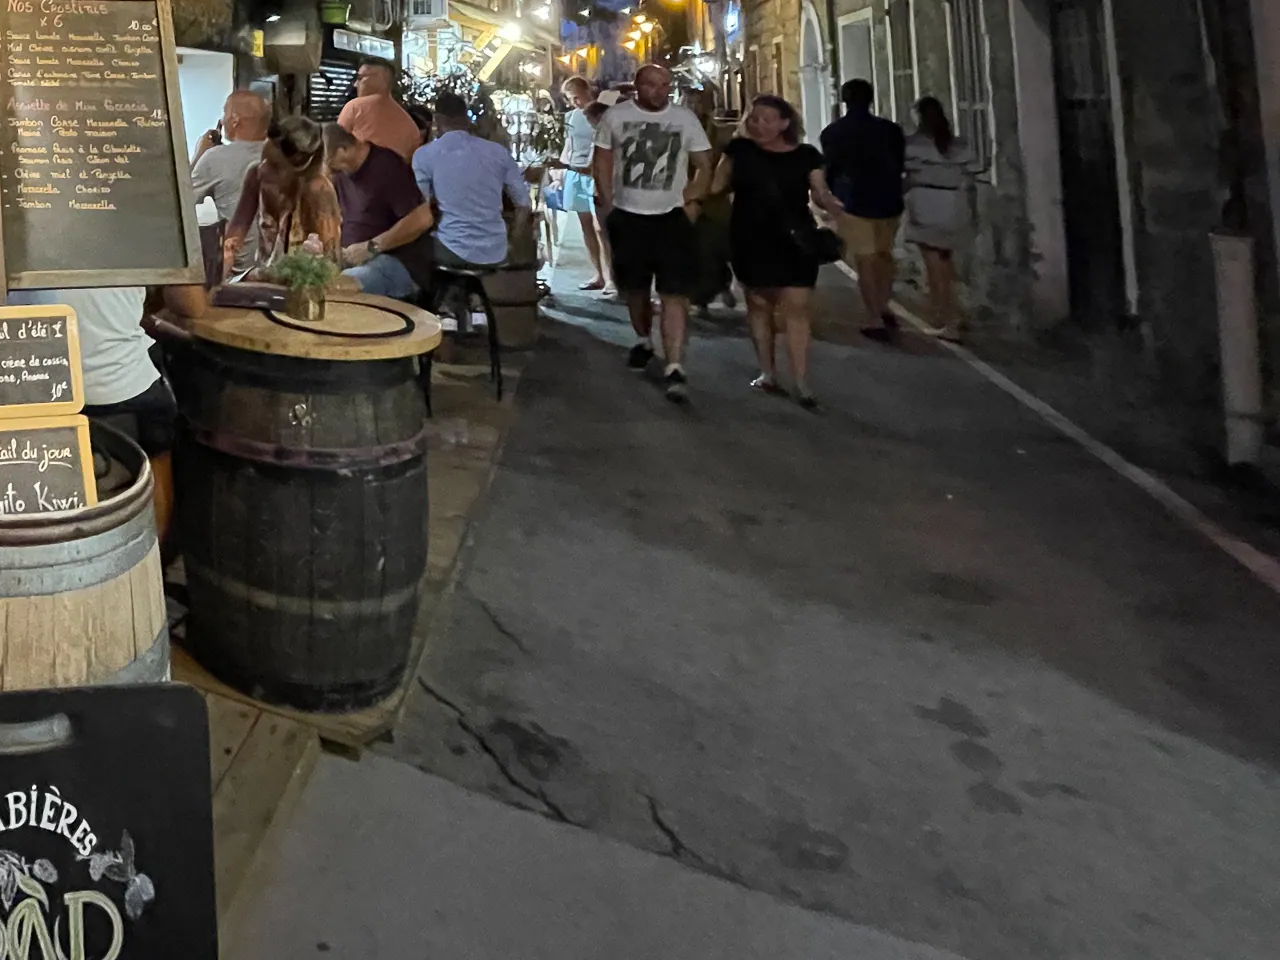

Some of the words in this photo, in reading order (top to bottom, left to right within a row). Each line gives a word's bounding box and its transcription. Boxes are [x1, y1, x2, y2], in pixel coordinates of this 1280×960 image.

[7, 117, 44, 127] Jambon
[75, 184, 111, 194] Chorizo
[16, 197, 52, 209] Jambon
[68, 199, 117, 210] Mozzarella
[18, 321, 48, 341] d'été
[28, 354, 41, 368] de
[22, 442, 39, 460] du
[38, 443, 73, 473] jour
[4, 784, 99, 857] BIÈRES
